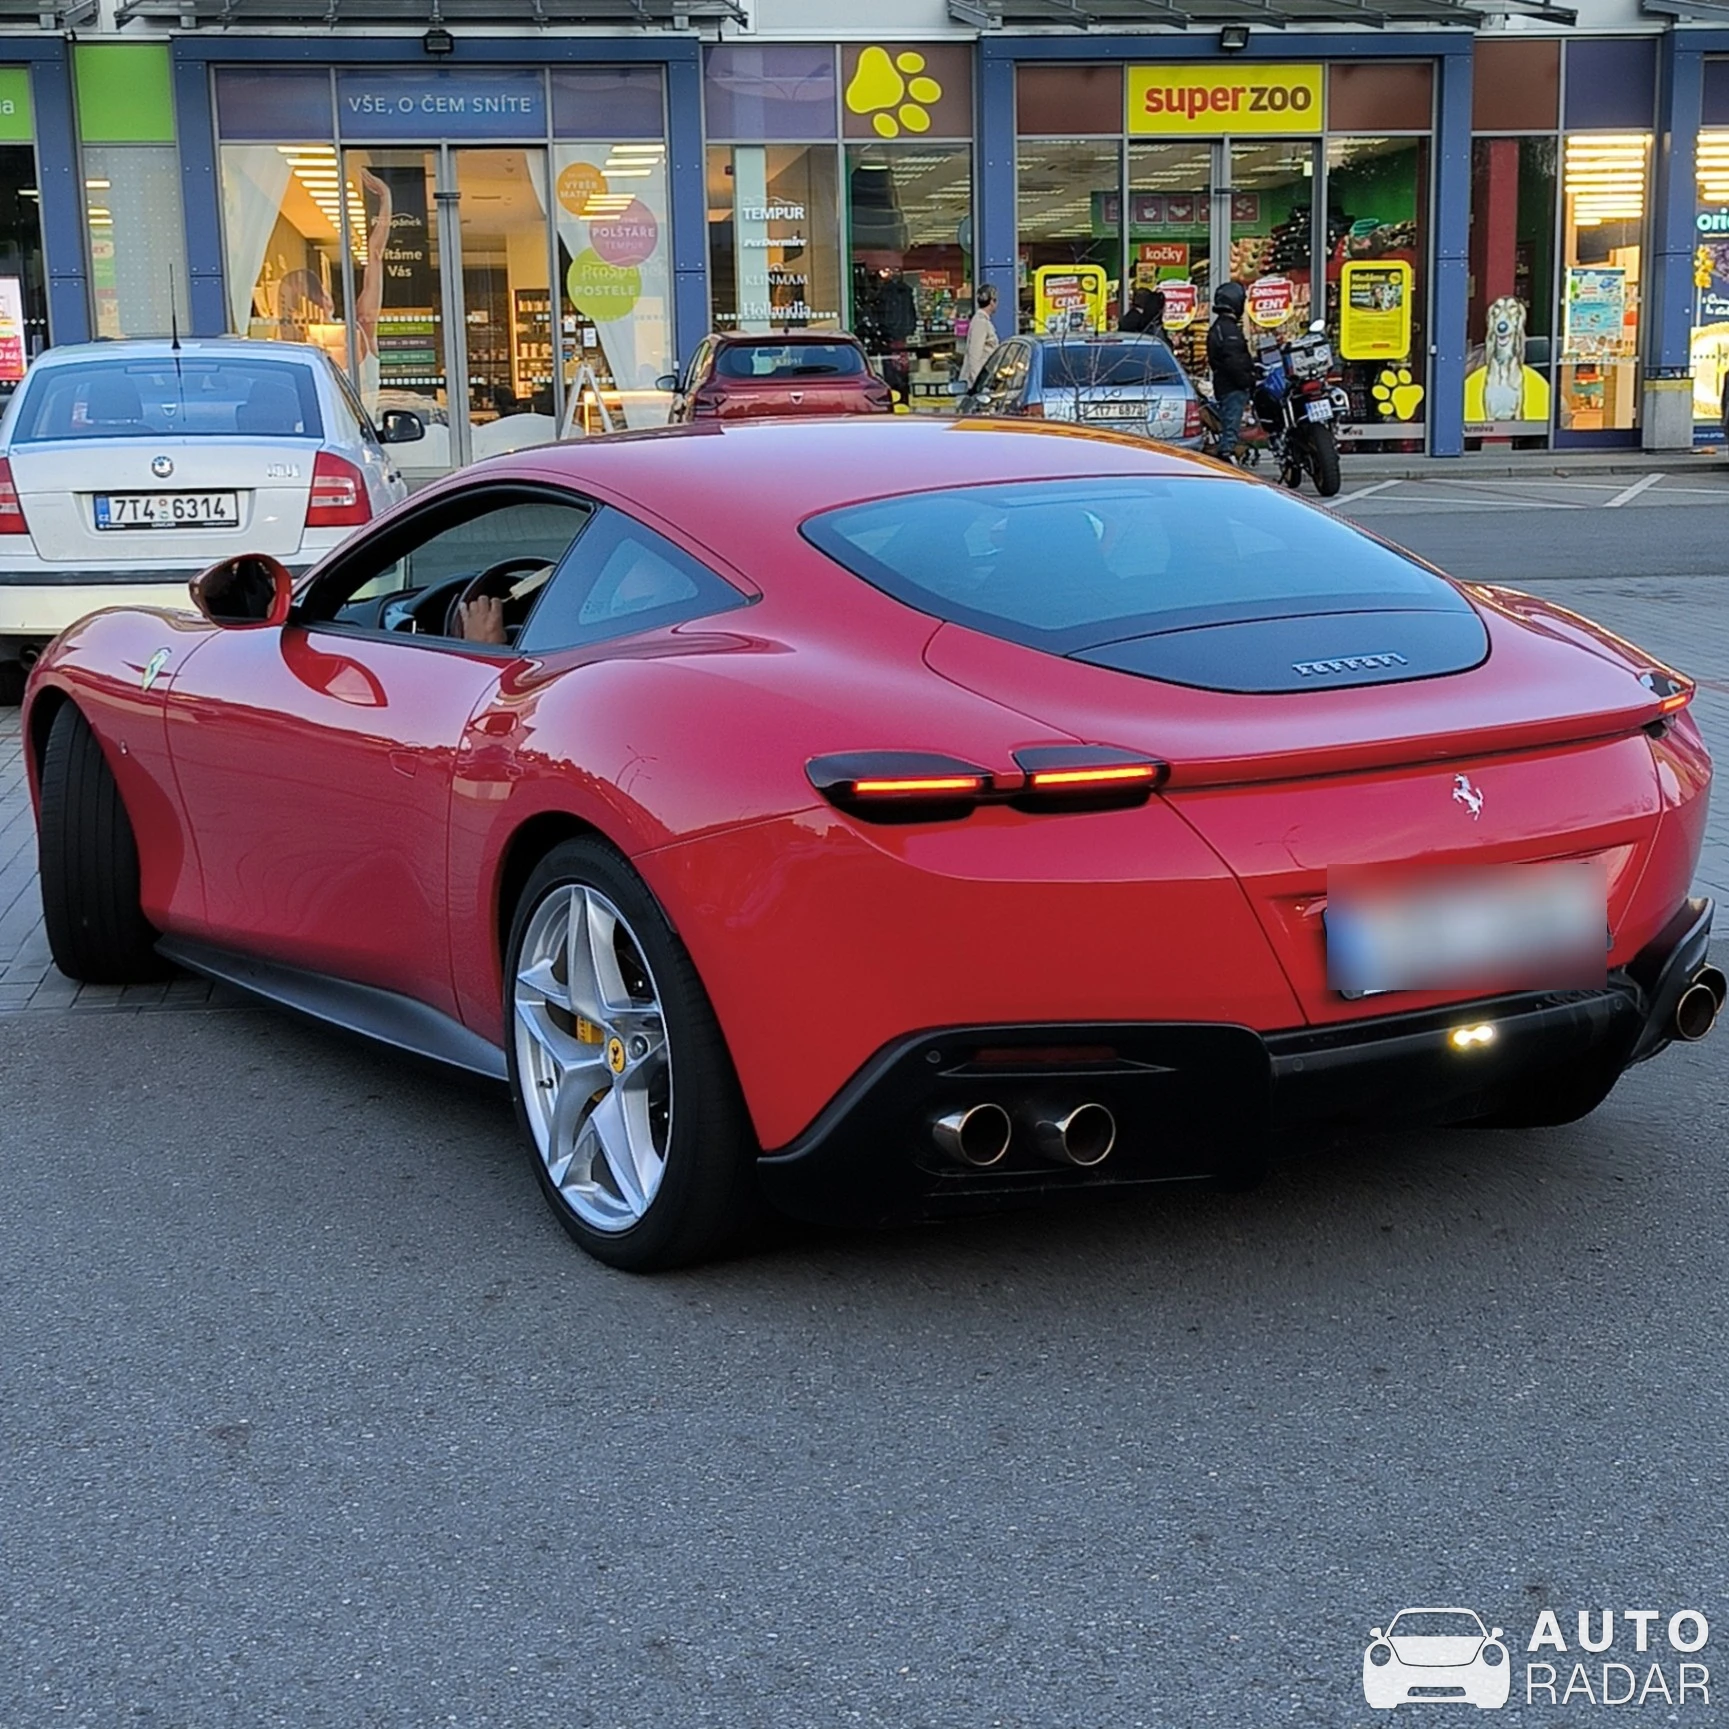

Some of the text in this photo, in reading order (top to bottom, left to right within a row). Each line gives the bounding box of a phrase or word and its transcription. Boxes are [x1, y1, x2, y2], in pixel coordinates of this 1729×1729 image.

[348, 93, 531, 114] VŠE, O ČEM SNÍTE
[742, 207, 805, 220] TEMPUR
[1697, 207, 1729, 231] ori
[384, 249, 423, 260] ítáme
[1146, 247, 1184, 263] kočky
[387, 265, 412, 277] Vás
[743, 301, 811, 319] Hollandia
[115, 497, 226, 521] 7T4 6314
